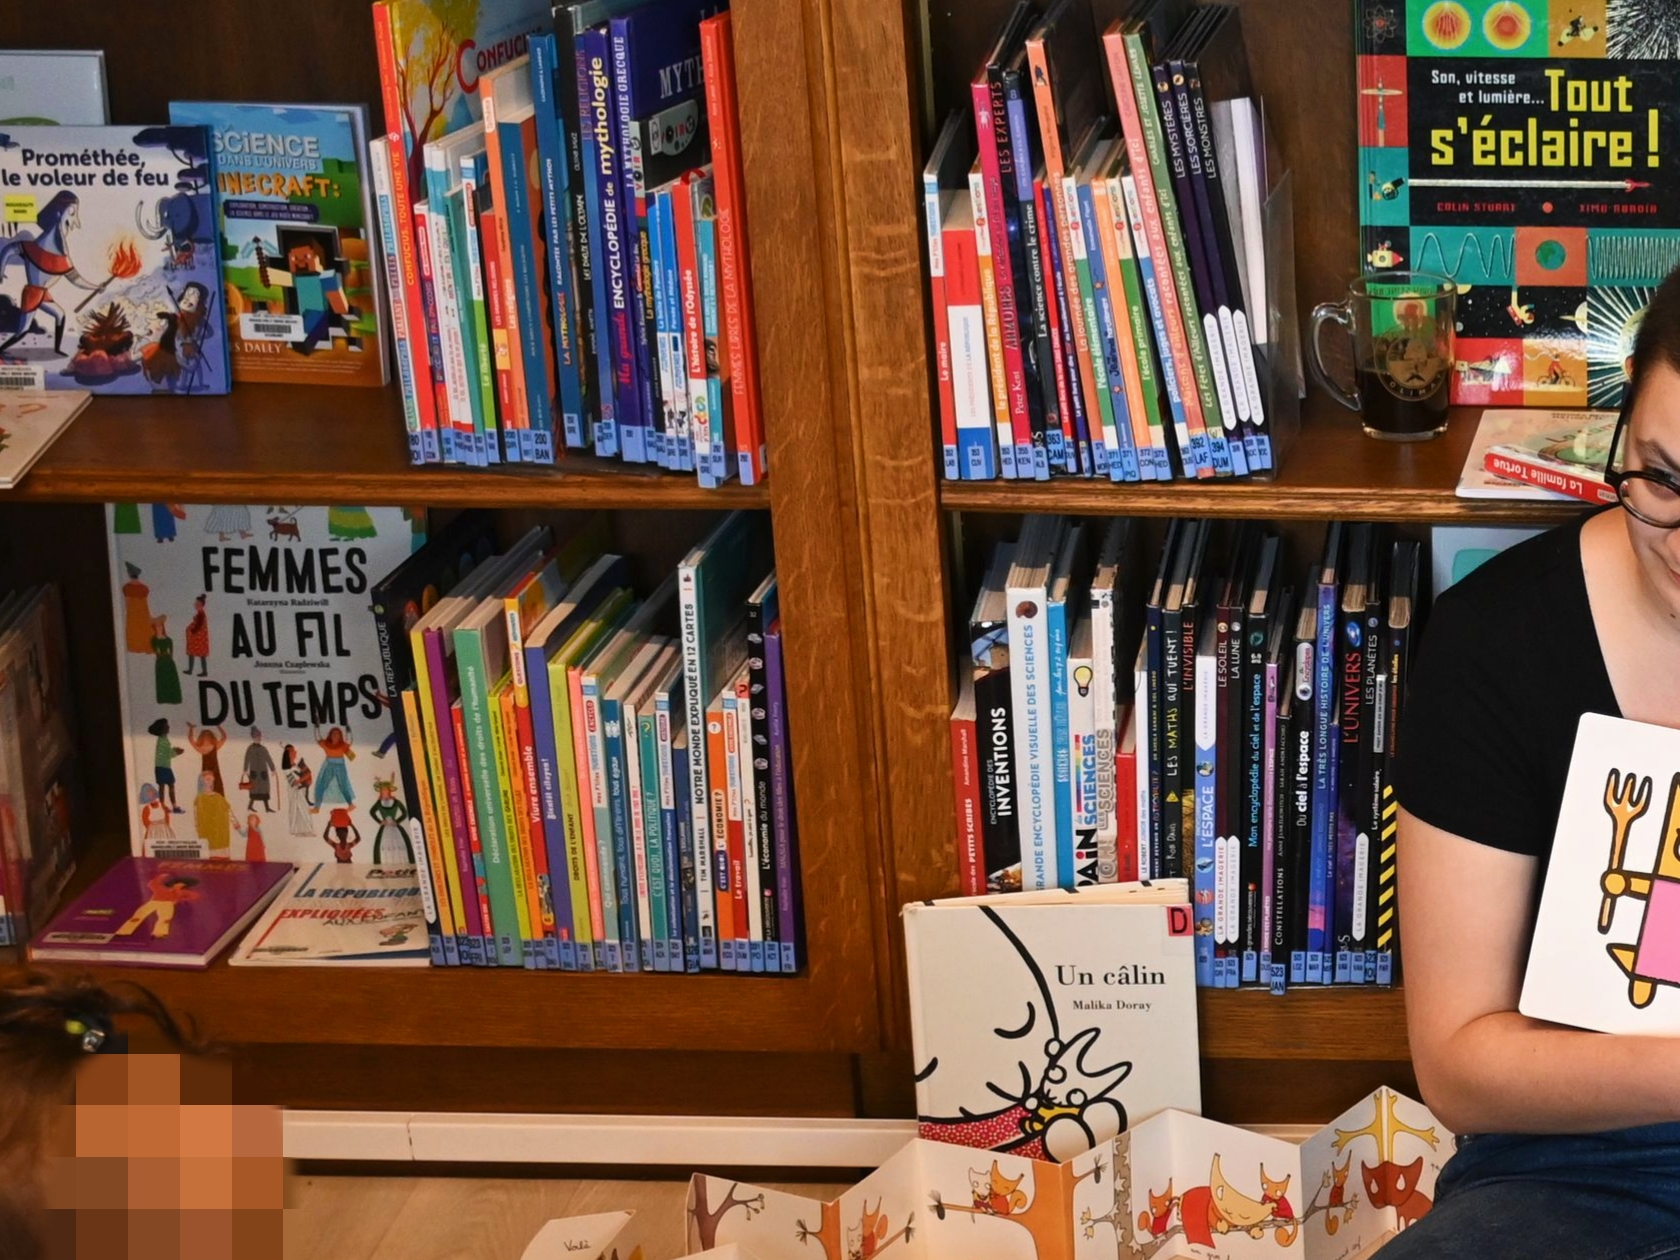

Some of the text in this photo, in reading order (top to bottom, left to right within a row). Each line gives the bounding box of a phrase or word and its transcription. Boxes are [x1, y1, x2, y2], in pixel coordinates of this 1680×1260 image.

[1432, 70, 1516, 87] Son, vitesse
[1459, 90, 1474, 104] et
[1544, 69, 1633, 112] Tout
[589, 57, 615, 175] mythologie
[991, 81, 1012, 173] LES EXPERTS
[1161, 100, 1186, 178] LES MYSTÈRES
[1177, 93, 1202, 174] LES SORCIÈRES
[1193, 97, 1216, 178] LES MONSTRES
[1432, 109, 1659, 167] s'éclaire !
[2, 170, 169, 187] le voleur de feu
[22, 148, 147, 169] Prométhée,
[392, 151, 400, 168] VIE
[395, 171, 404, 191] UNE
[218, 172, 341, 198] INECRAFT:
[397, 194, 408, 223] TOUTE
[605, 182, 614, 196] de
[603, 199, 625, 308] ENCYCLOPÉDIE
[682, 269, 703, 373] L'histoire de l'Odyssée
[1085, 297, 1106, 388] l'école élémentaire
[1131, 306, 1151, 380] l'école primaire
[245, 343, 282, 353] DALLY
[938, 342, 949, 381] Le maire
[1012, 371, 1025, 414] Peter Kent
[534, 433, 548, 445] 200
[1047, 433, 1061, 445] 363
[1191, 436, 1205, 448] 392
[1211, 441, 1225, 453] 394
[1493, 458, 1583, 494] La famille Tortue
[202, 546, 368, 594] FEMMES
[231, 611, 351, 658] AU FIL
[1024, 625, 1035, 680] SCIENCES
[1182, 621, 1194, 690] L'INVISIBLE
[1218, 640, 1227, 687] LE SOLEIL
[1231, 639, 1240, 679] LA LUNE
[1365, 634, 1377, 705] LES PLANÈTES
[198, 675, 383, 728] DU TEMPS
[684, 603, 704, 804] NOTRE MONDE EXPLIQUÉ EN 12 CARTES
[1026, 684, 1036, 705] DES
[1343, 652, 1361, 743] L'UNIVERS
[1027, 709, 1039, 760] VISUELLE
[991, 707, 1013, 816] INVENTIONS
[1081, 734, 1097, 825] SCIENCES
[1027, 763, 1043, 847] ENCYCLOPÉDIE
[1200, 786, 1215, 847] L'ESPACE
[697, 828, 706, 867] MARSHALL
[1170, 907, 1187, 934] D
[1274, 867, 1284, 945] CONSTELLATIONS
[1055, 964, 1166, 986] Un câlin
[1073, 1000, 1152, 1012] Malika Doray
